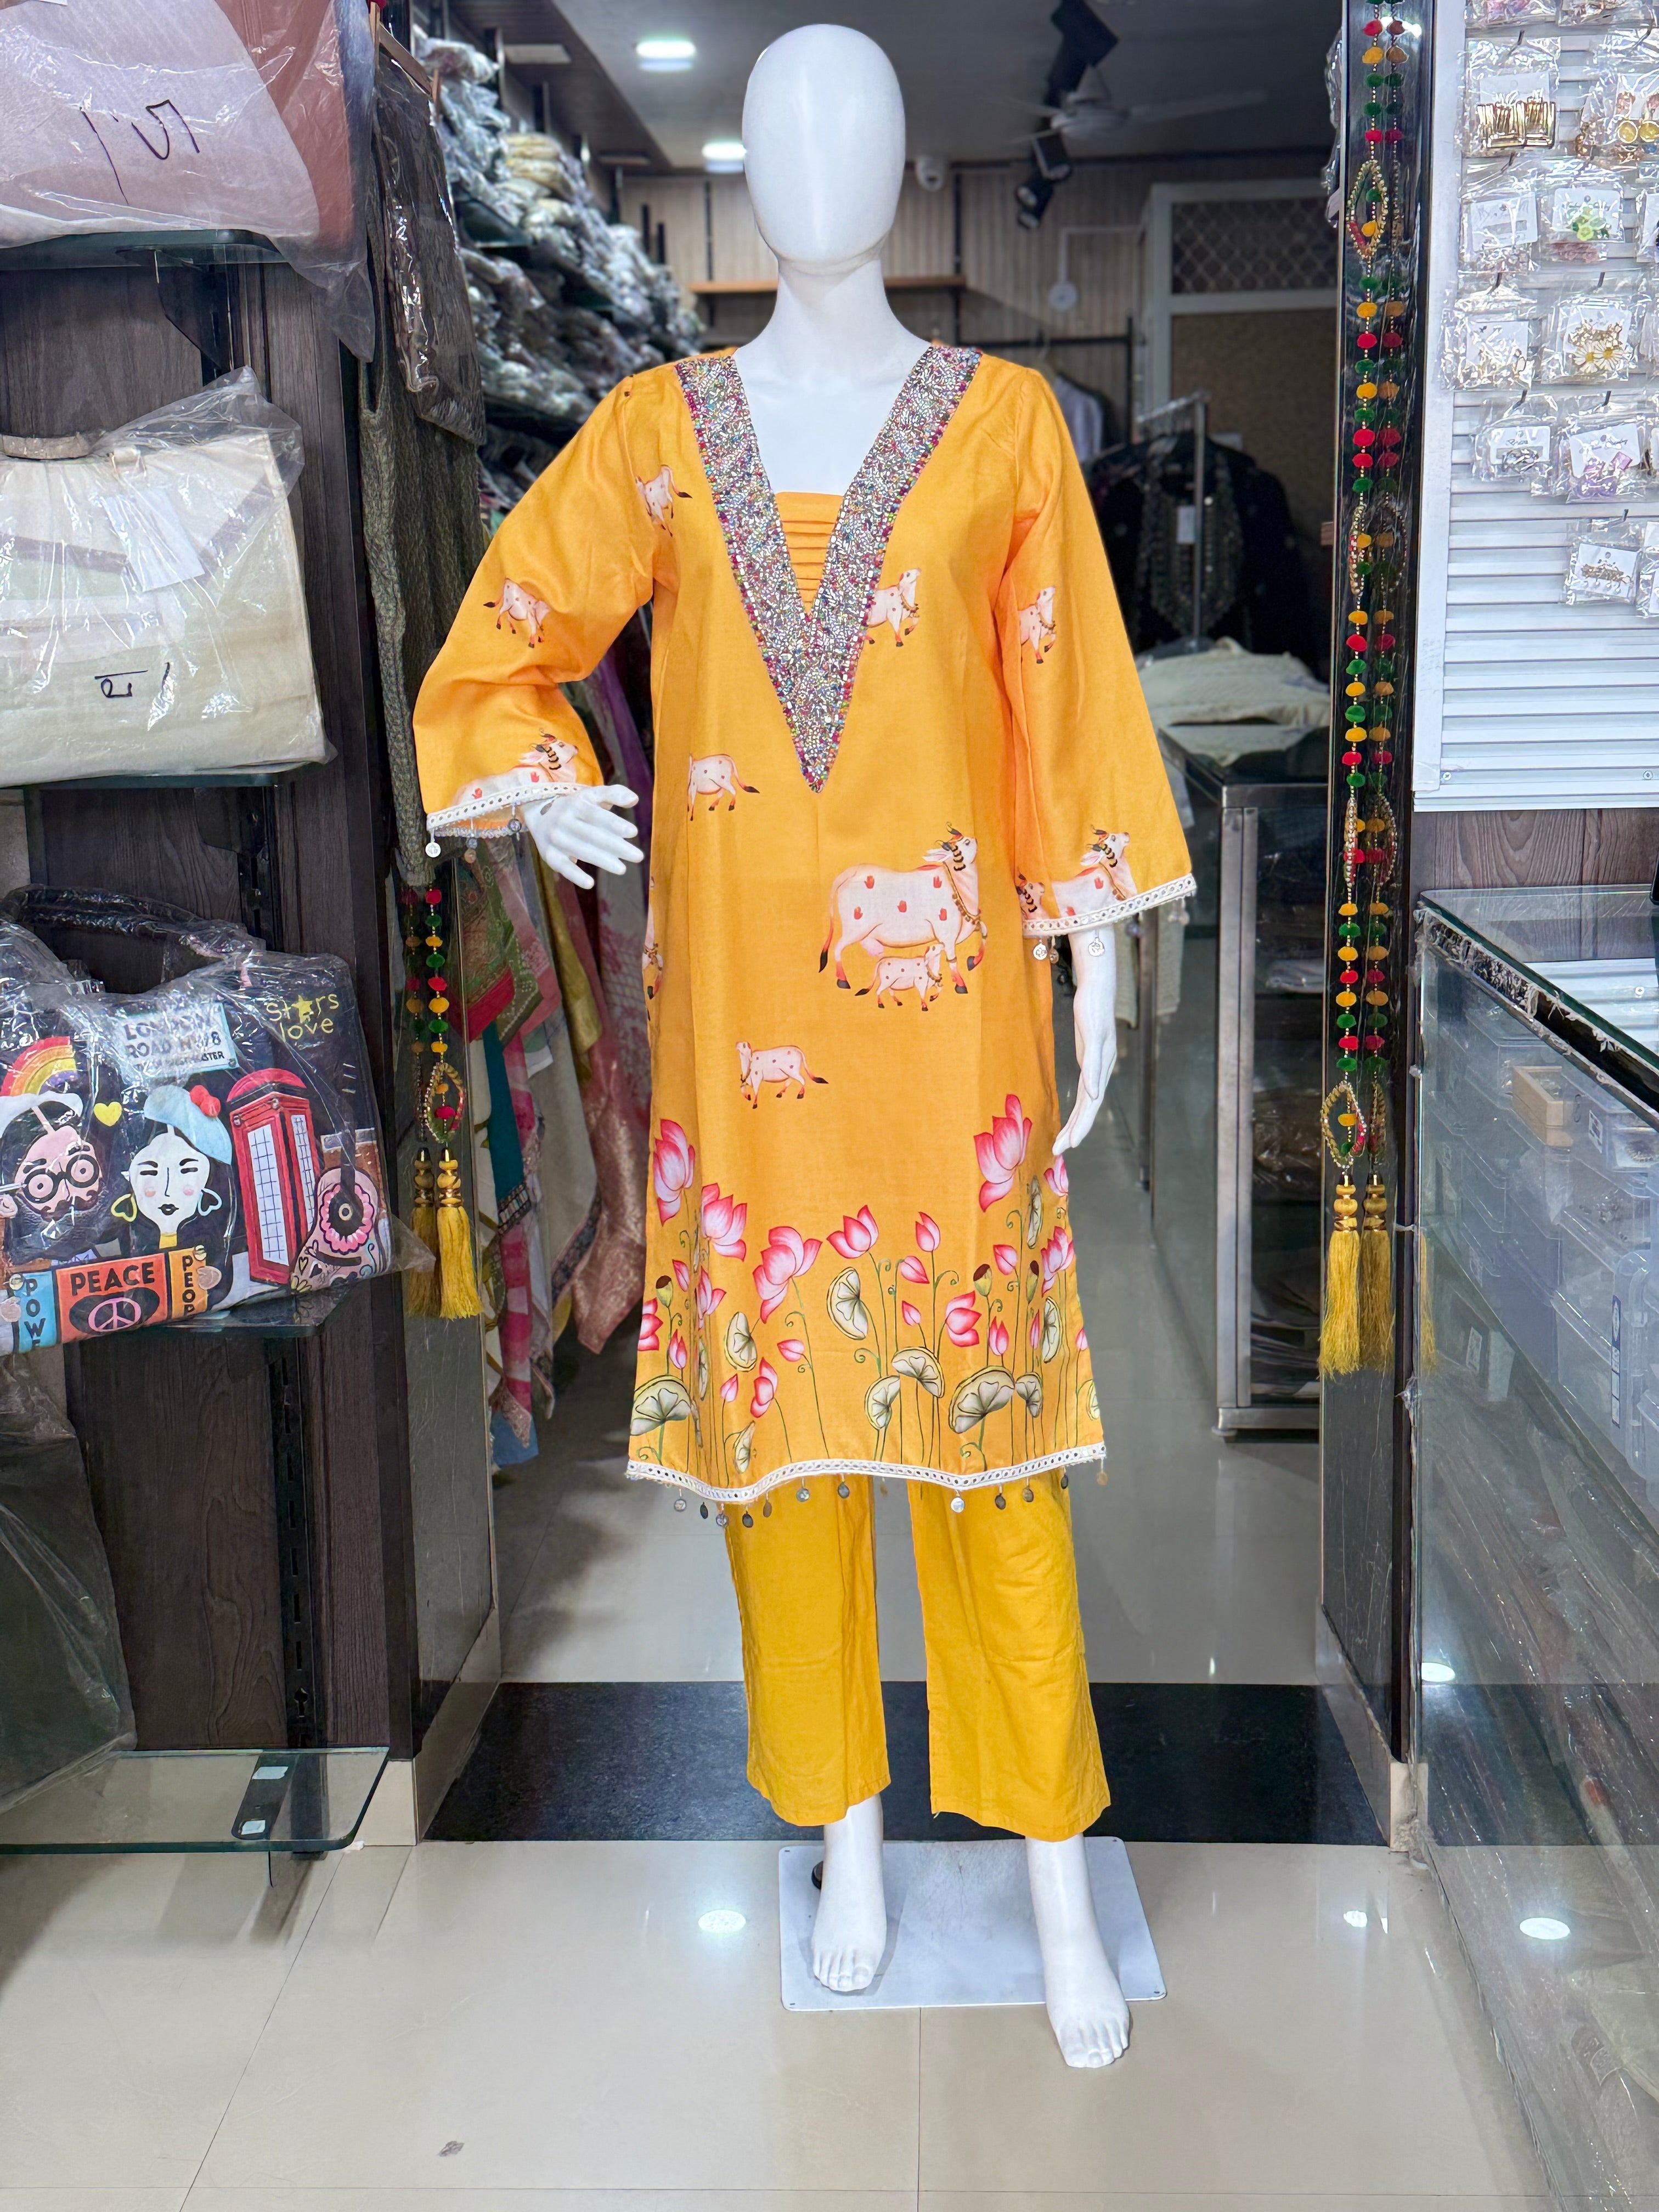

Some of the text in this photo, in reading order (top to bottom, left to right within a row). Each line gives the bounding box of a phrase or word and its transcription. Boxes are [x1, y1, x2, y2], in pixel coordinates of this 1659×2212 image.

[266, 994, 339, 1024] Strs
[280, 1018, 334, 1042] love
[70, 1262, 155, 1296] PEACE
